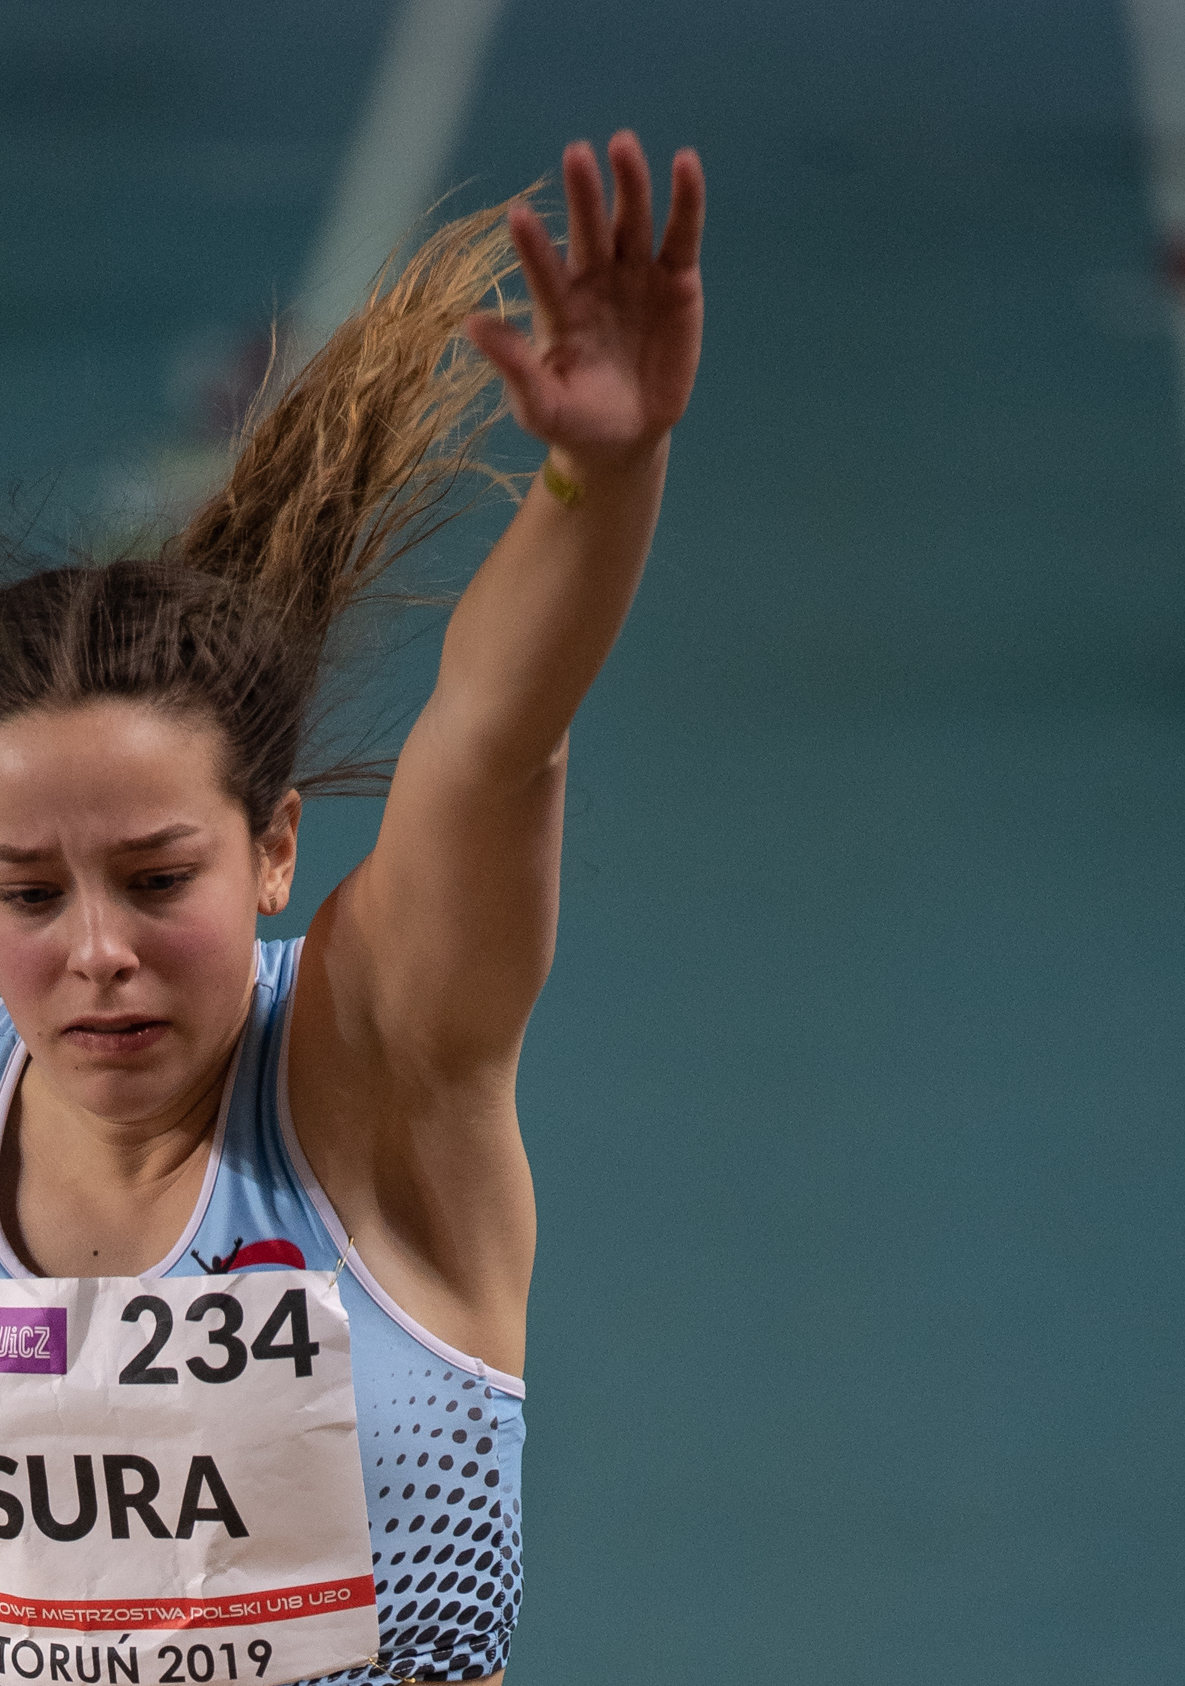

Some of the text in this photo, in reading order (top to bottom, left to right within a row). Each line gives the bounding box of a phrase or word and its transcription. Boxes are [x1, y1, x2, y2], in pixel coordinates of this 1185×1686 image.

[118, 1287, 320, 1386] 234
[41, 1606, 187, 1623] MISTRZOSTWA
[189, 1600, 262, 1620] POLSKI
[266, 1594, 304, 1613] U18
[308, 1587, 352, 1606] U20
[157, 1638, 273, 1684] 2019
